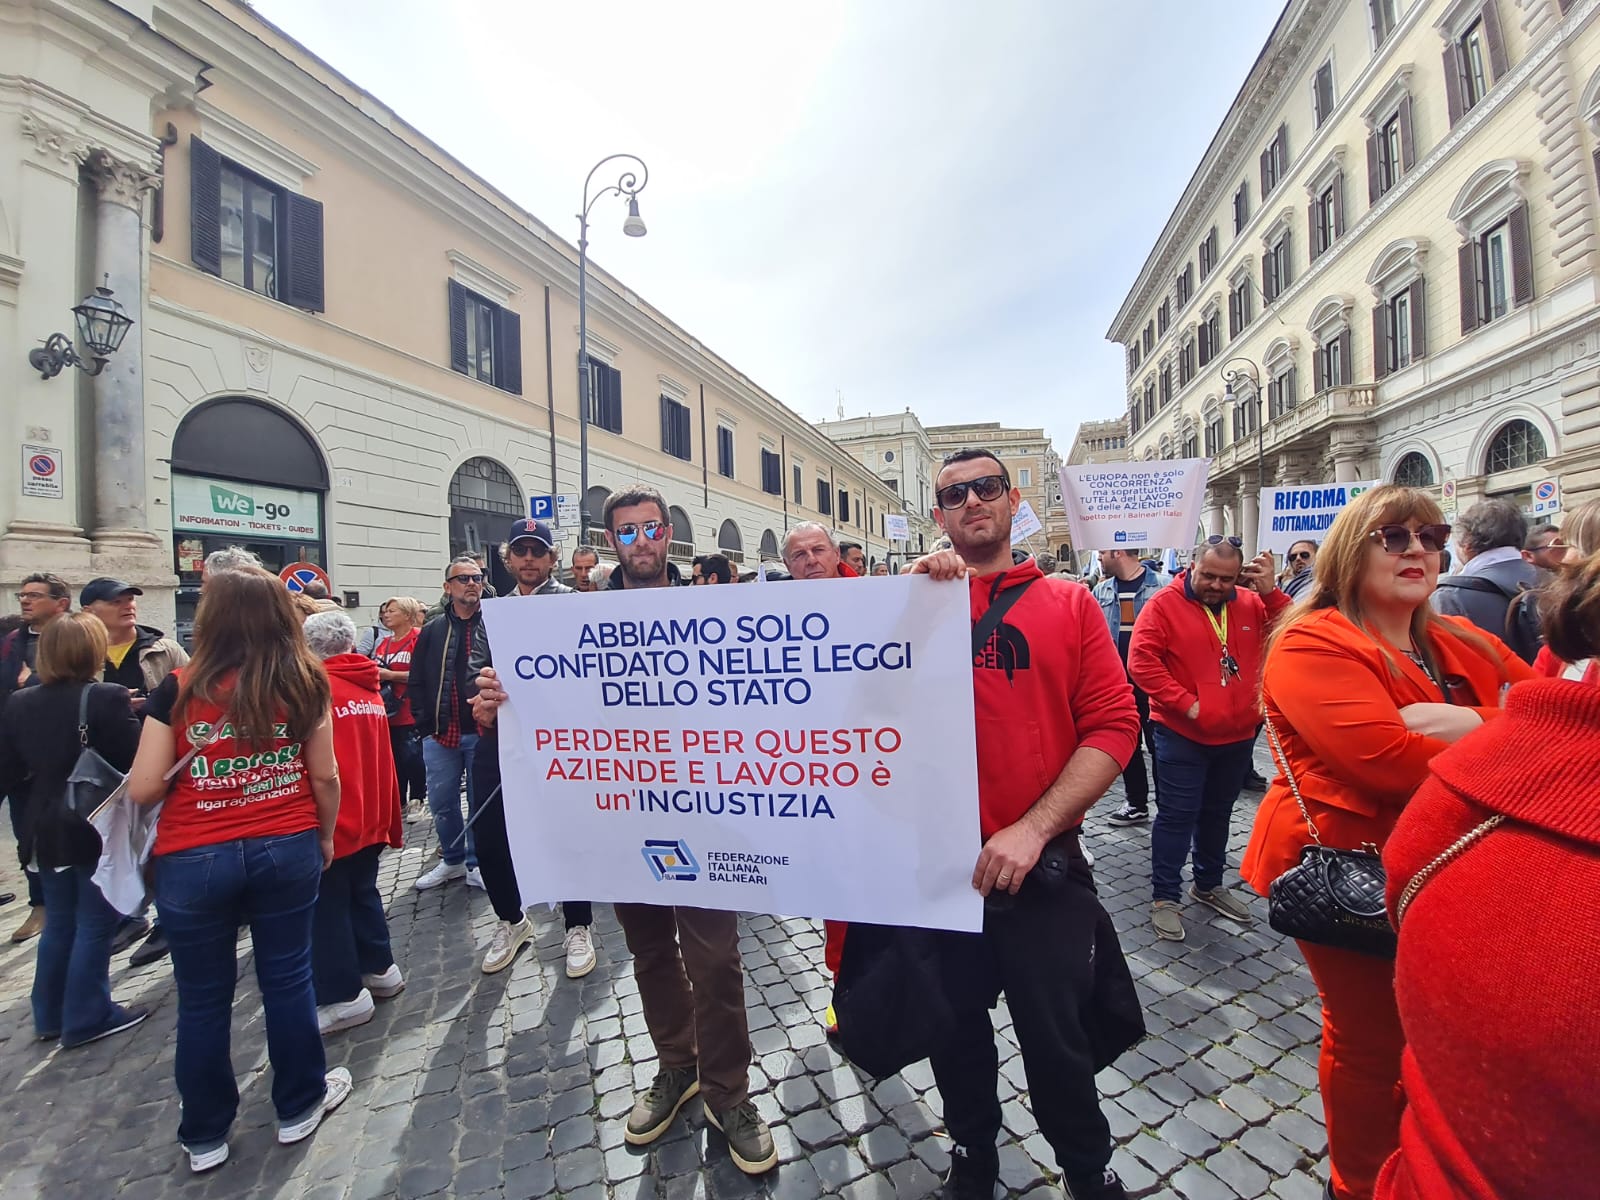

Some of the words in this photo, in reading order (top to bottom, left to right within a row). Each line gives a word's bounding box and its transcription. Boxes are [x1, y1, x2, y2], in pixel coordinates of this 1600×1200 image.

[1079, 473, 1129, 482] L'EUROPA
[1163, 469, 1184, 478] solo
[1090, 478, 1173, 489] CONCORRENZA
[1080, 496, 1118, 504] TUTELA
[1120, 494, 1136, 503] del
[1139, 491, 1184, 502] LAVORO
[1112, 486, 1169, 498] soprattutto
[1274, 488, 1347, 510] RIFORMA
[536, 500, 547, 515] P
[1097, 502, 1121, 511] delle
[1124, 501, 1175, 510] AZIENDE.
[1108, 513, 1121, 521] per
[1128, 511, 1161, 519] Balneari
[1272, 513, 1339, 532] ROTTAMAZION
[179, 514, 240, 527] INFORMATION
[248, 521, 281, 531] TICKETS
[288, 526, 314, 534] GUIDES
[524, 519, 536, 531] B
[579, 616, 727, 649] ABBIAMO
[736, 612, 830, 644] SOLO
[515, 649, 689, 681] CONFIDATO
[699, 647, 803, 675] NELLE
[813, 642, 912, 673] LEGGI
[602, 680, 699, 707] DELLO
[707, 677, 812, 706] STATO
[335, 706, 349, 718] La
[536, 729, 673, 753] PERDERE
[683, 730, 746, 753] PER
[756, 726, 902, 758] QUESTO
[191, 755, 209, 778] il
[547, 758, 678, 784] AZIENDE
[689, 761, 706, 784] E
[717, 761, 860, 787] LAVORO
[872, 761, 892, 787] è
[196, 784, 300, 812] ilgarageanzio.it
[596, 789, 835, 819] un'INGIUSTIZIA
[707, 851, 790, 866] FEDERAZIONE
[708, 862, 761, 875] ITALIANA
[709, 872, 768, 886] BALNEARI
